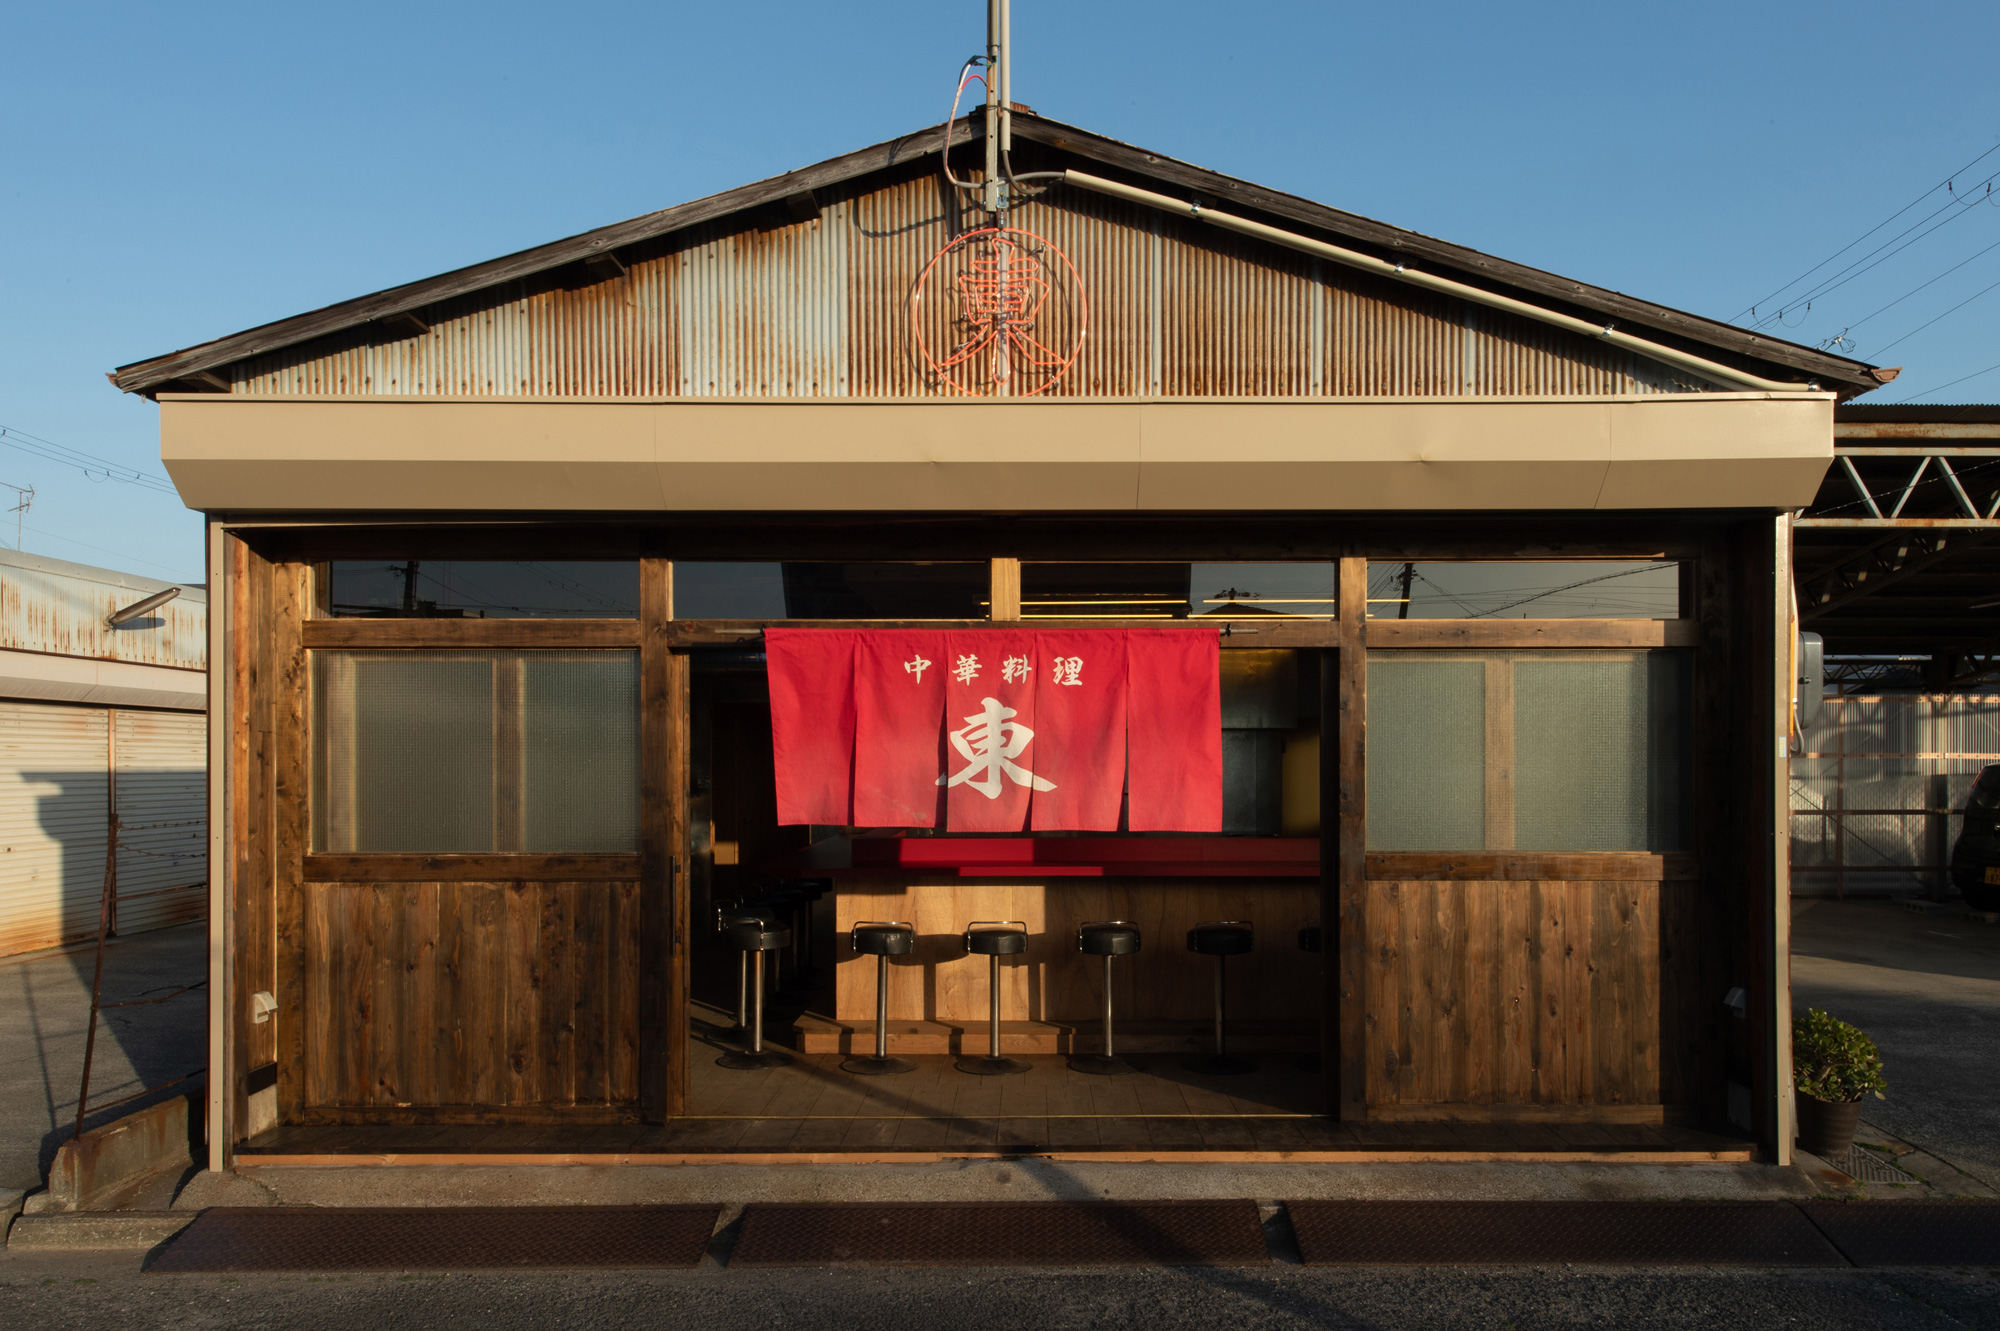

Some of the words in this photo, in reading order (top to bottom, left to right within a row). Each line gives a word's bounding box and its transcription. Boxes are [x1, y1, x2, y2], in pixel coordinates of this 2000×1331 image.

[938, 237, 1068, 386] 東
[903, 653, 1084, 686] 中華料理
[934, 696, 1058, 800] 東
